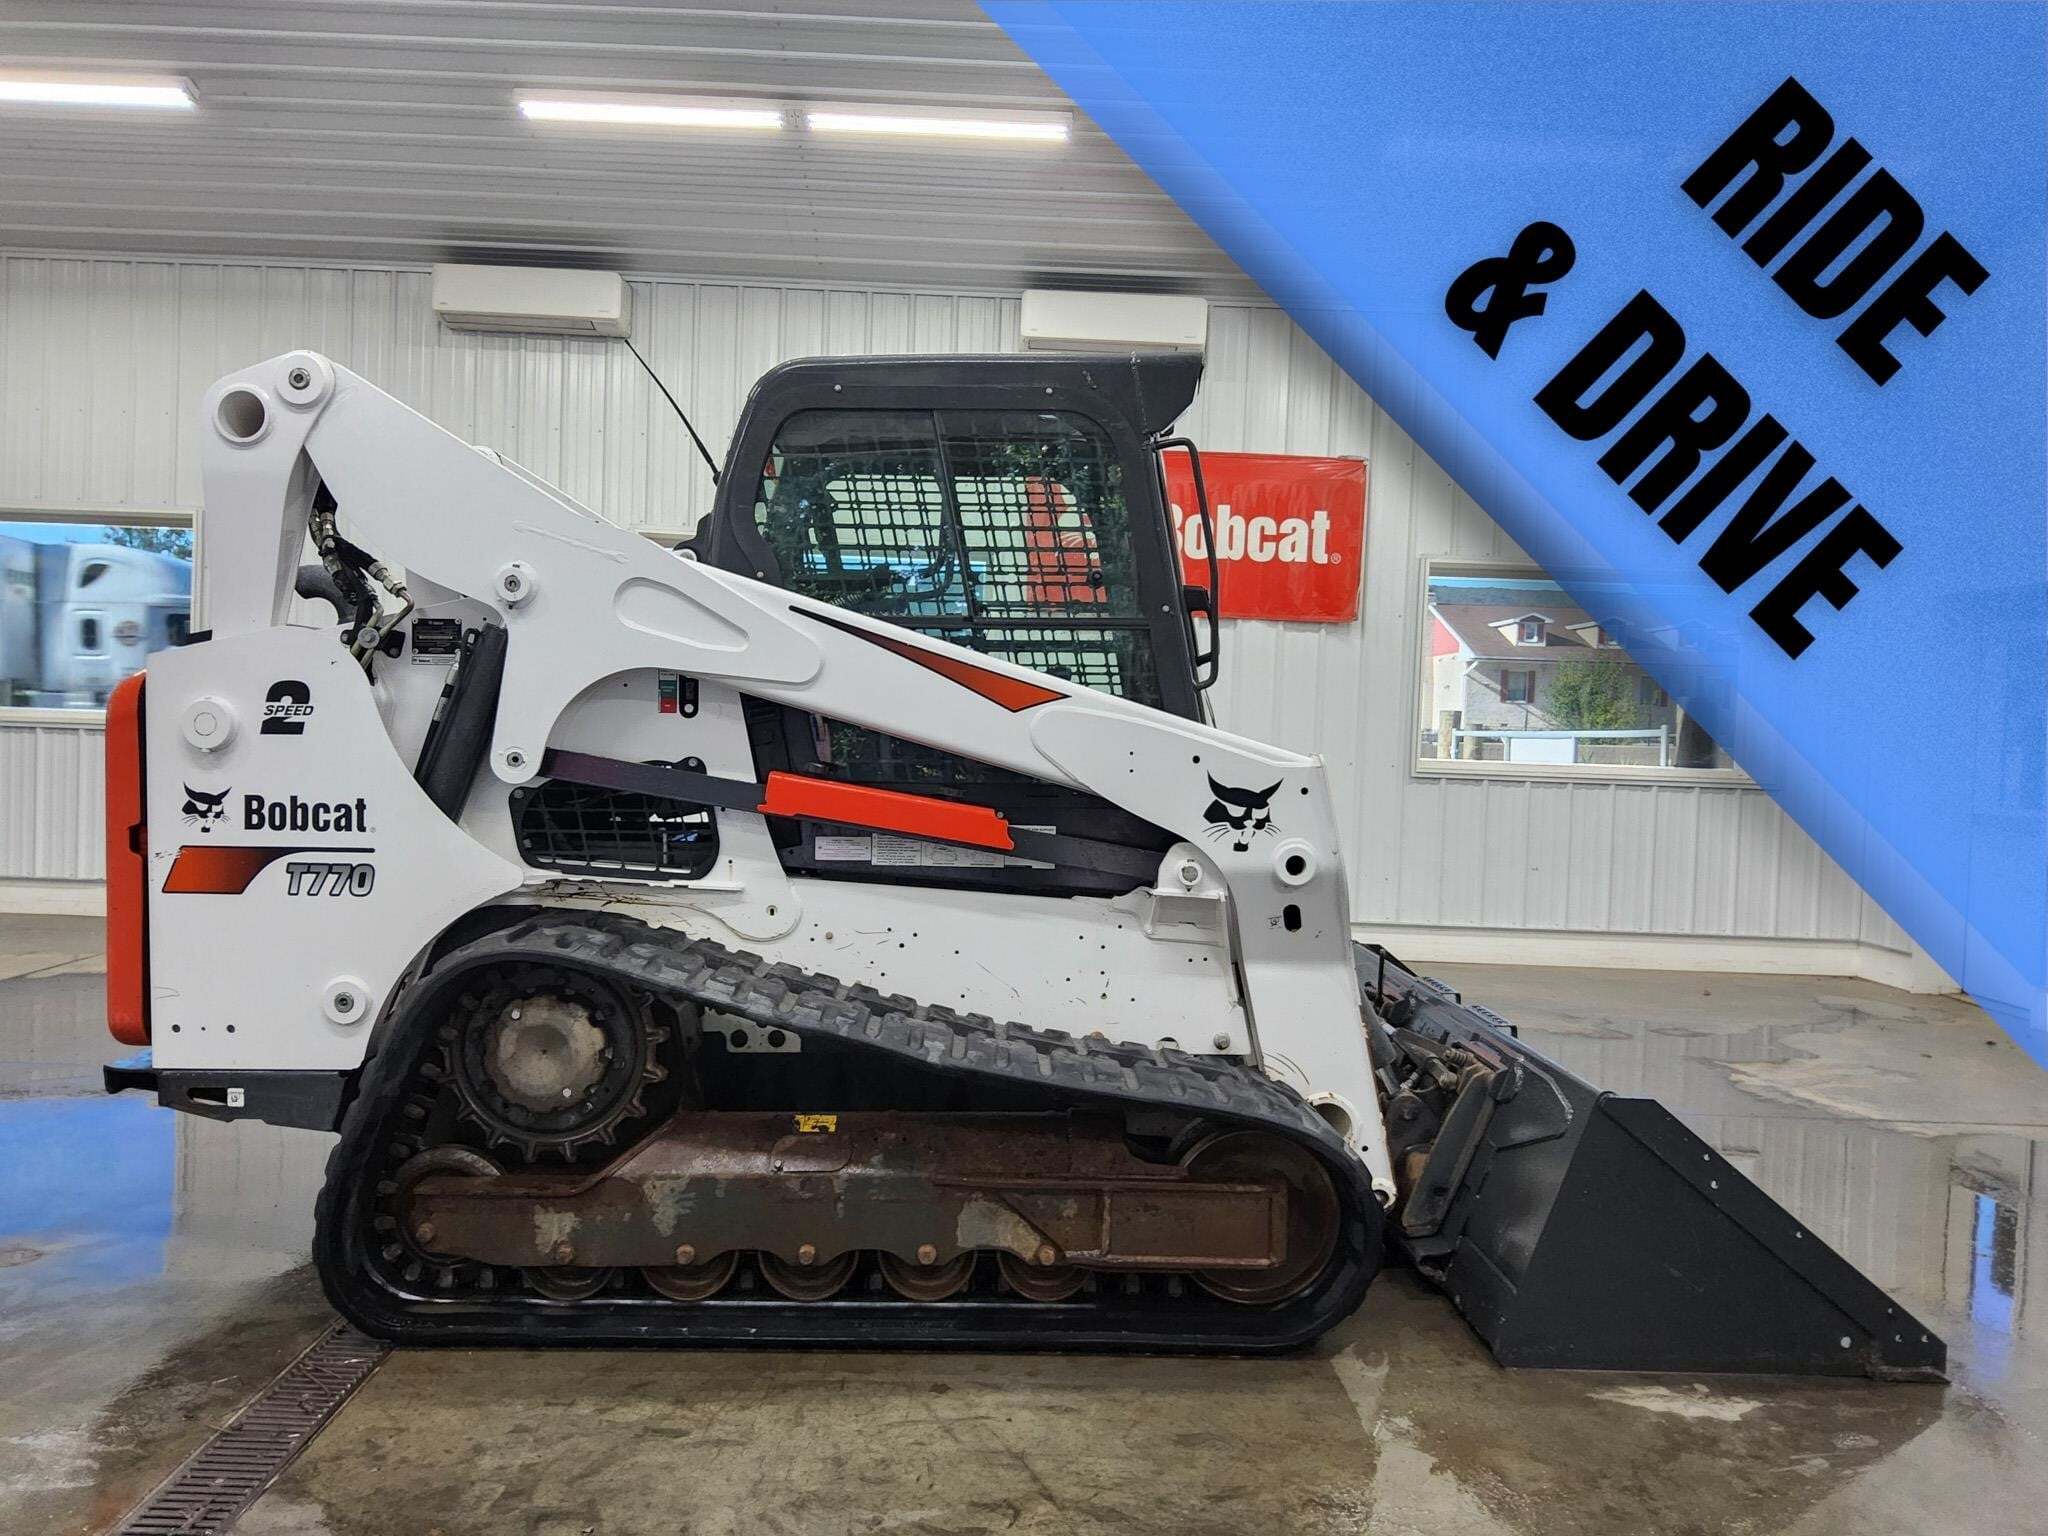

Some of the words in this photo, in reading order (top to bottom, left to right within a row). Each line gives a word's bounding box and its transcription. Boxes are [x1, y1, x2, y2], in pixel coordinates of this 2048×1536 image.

[260, 680, 311, 735] 2
[263, 704, 314, 717] SPEED
[244, 794, 367, 833] Bobcat
[286, 861, 376, 897] T770
